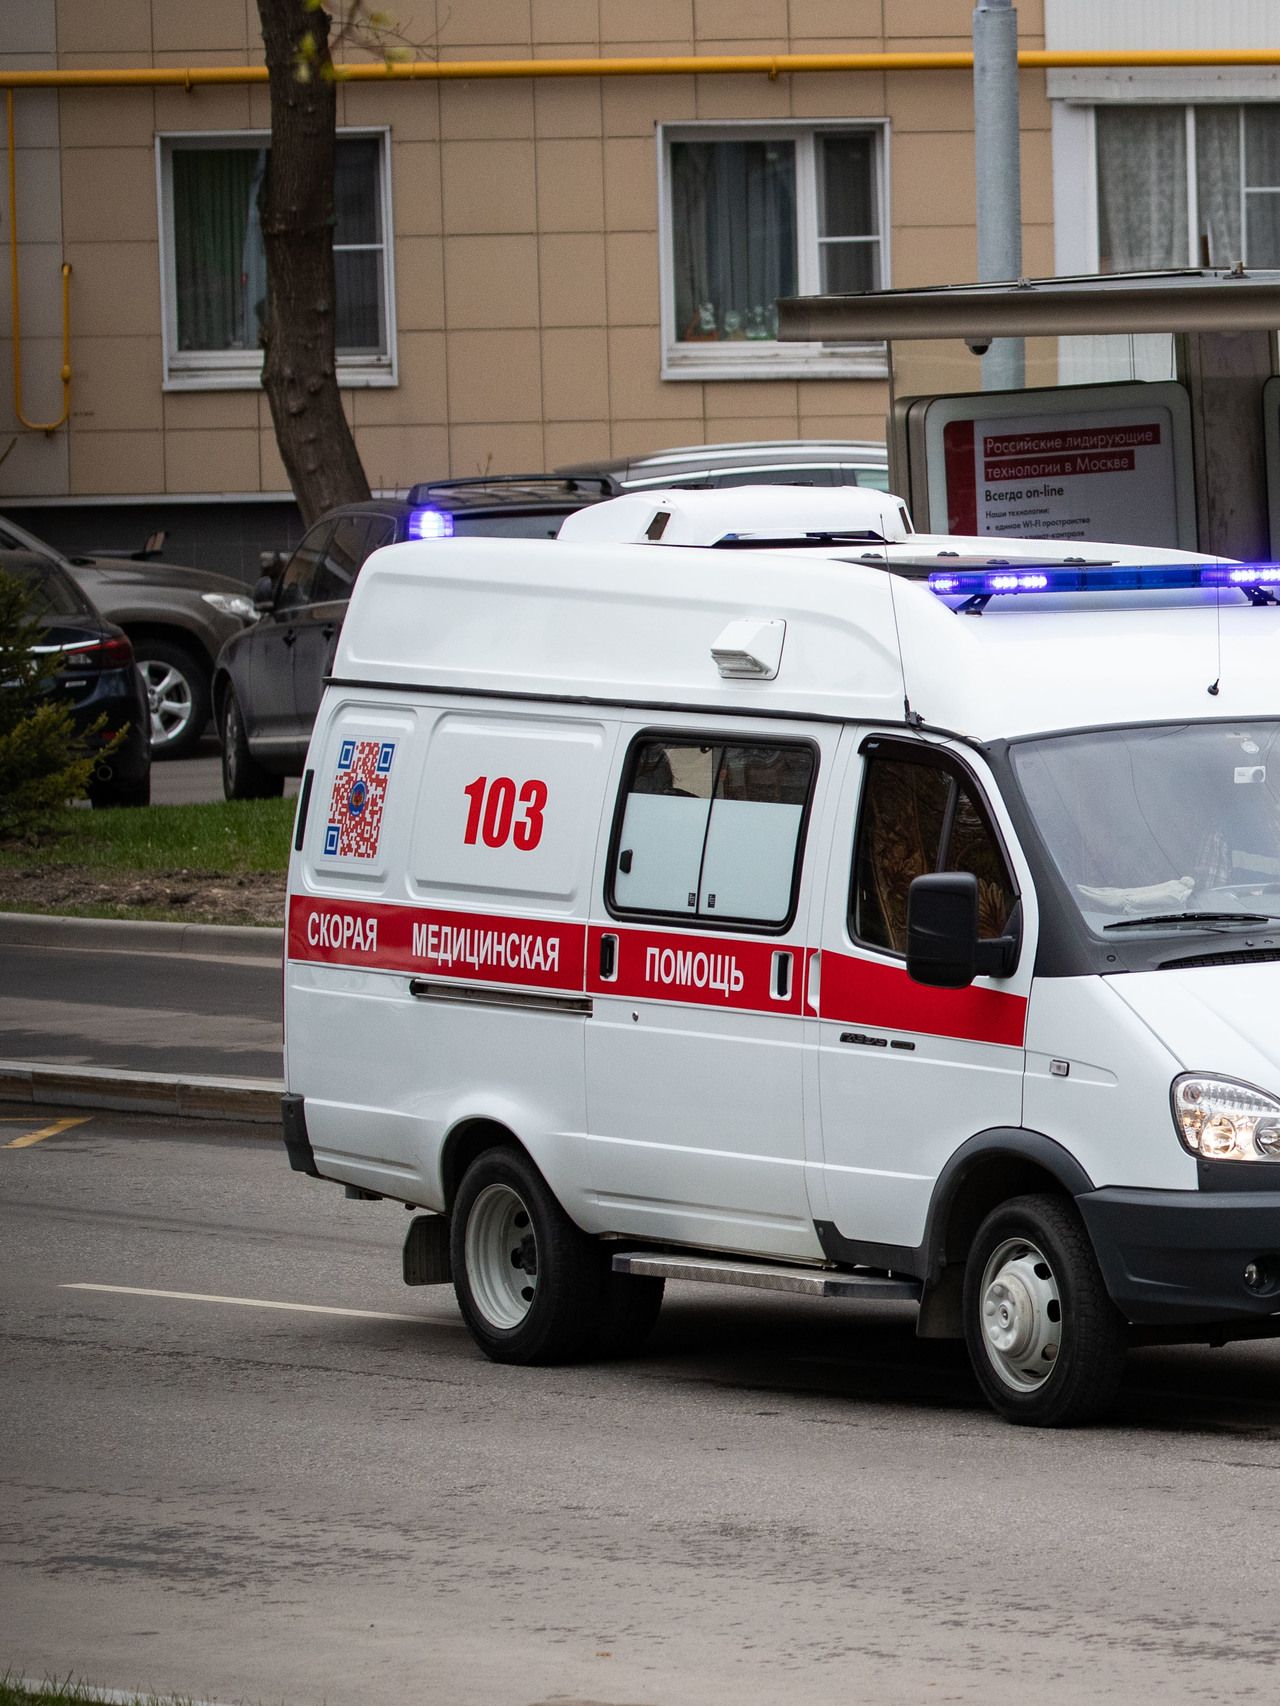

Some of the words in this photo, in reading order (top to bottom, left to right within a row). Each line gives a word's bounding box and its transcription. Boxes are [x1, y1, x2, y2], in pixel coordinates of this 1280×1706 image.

[987, 437, 1062, 454] Российские
[1065, 430, 1153, 448] лидирующие
[987, 461, 1061, 479] технологии
[1065, 464, 1072, 472] в
[1076, 457, 1129, 472] Москве
[985, 489, 1023, 502] Всегда
[1026, 484, 1064, 498] on-line
[985, 511, 1007, 519] Наши
[1008, 507, 1050, 517] технологии:
[995, 523, 1021, 531] единое
[1022, 520, 1041, 528] WI-FI
[1042, 517, 1091, 528] пространство
[463, 776, 548, 851] 103
[307, 912, 378, 952] СКОРАЯ
[412, 922, 560, 972] МЕДИЦИНСКАЯ
[645, 946, 745, 998] ПОМОЩЬ
